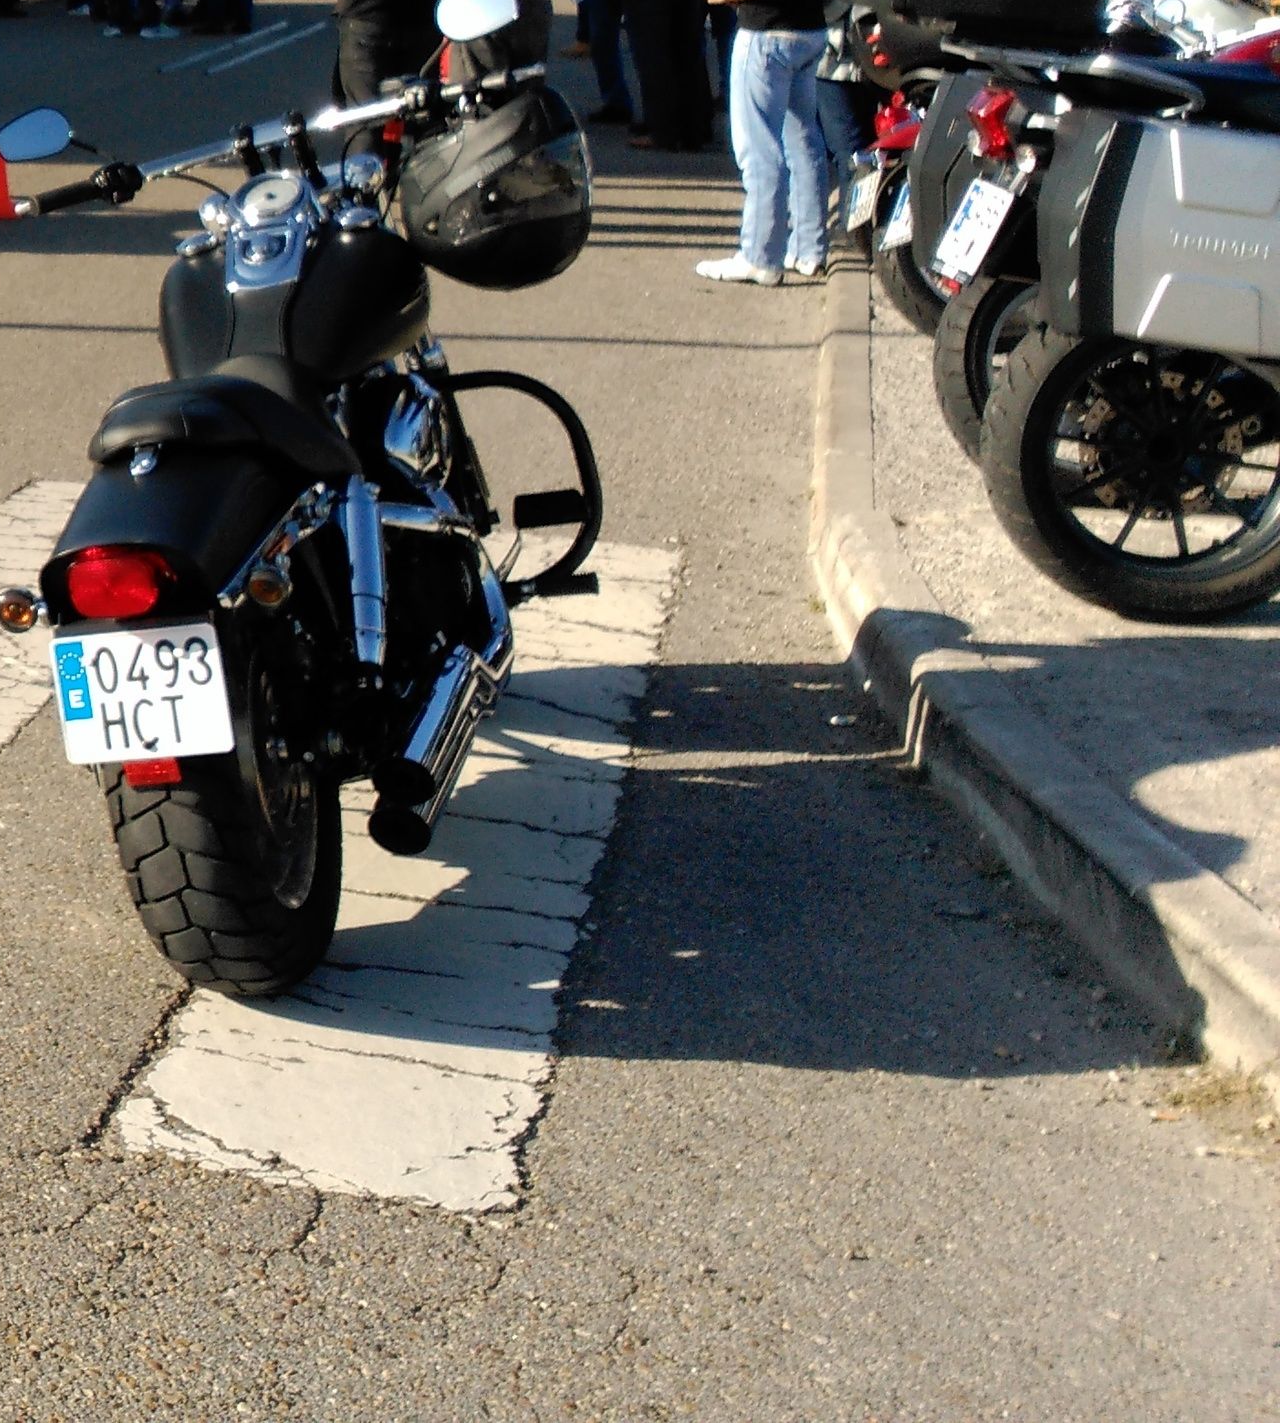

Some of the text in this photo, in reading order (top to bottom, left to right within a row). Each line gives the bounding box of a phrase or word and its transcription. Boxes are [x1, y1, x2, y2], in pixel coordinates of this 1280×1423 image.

[91, 635, 213, 695] 0493
[68, 688, 86, 709] E
[100, 693, 184, 752] HCT
